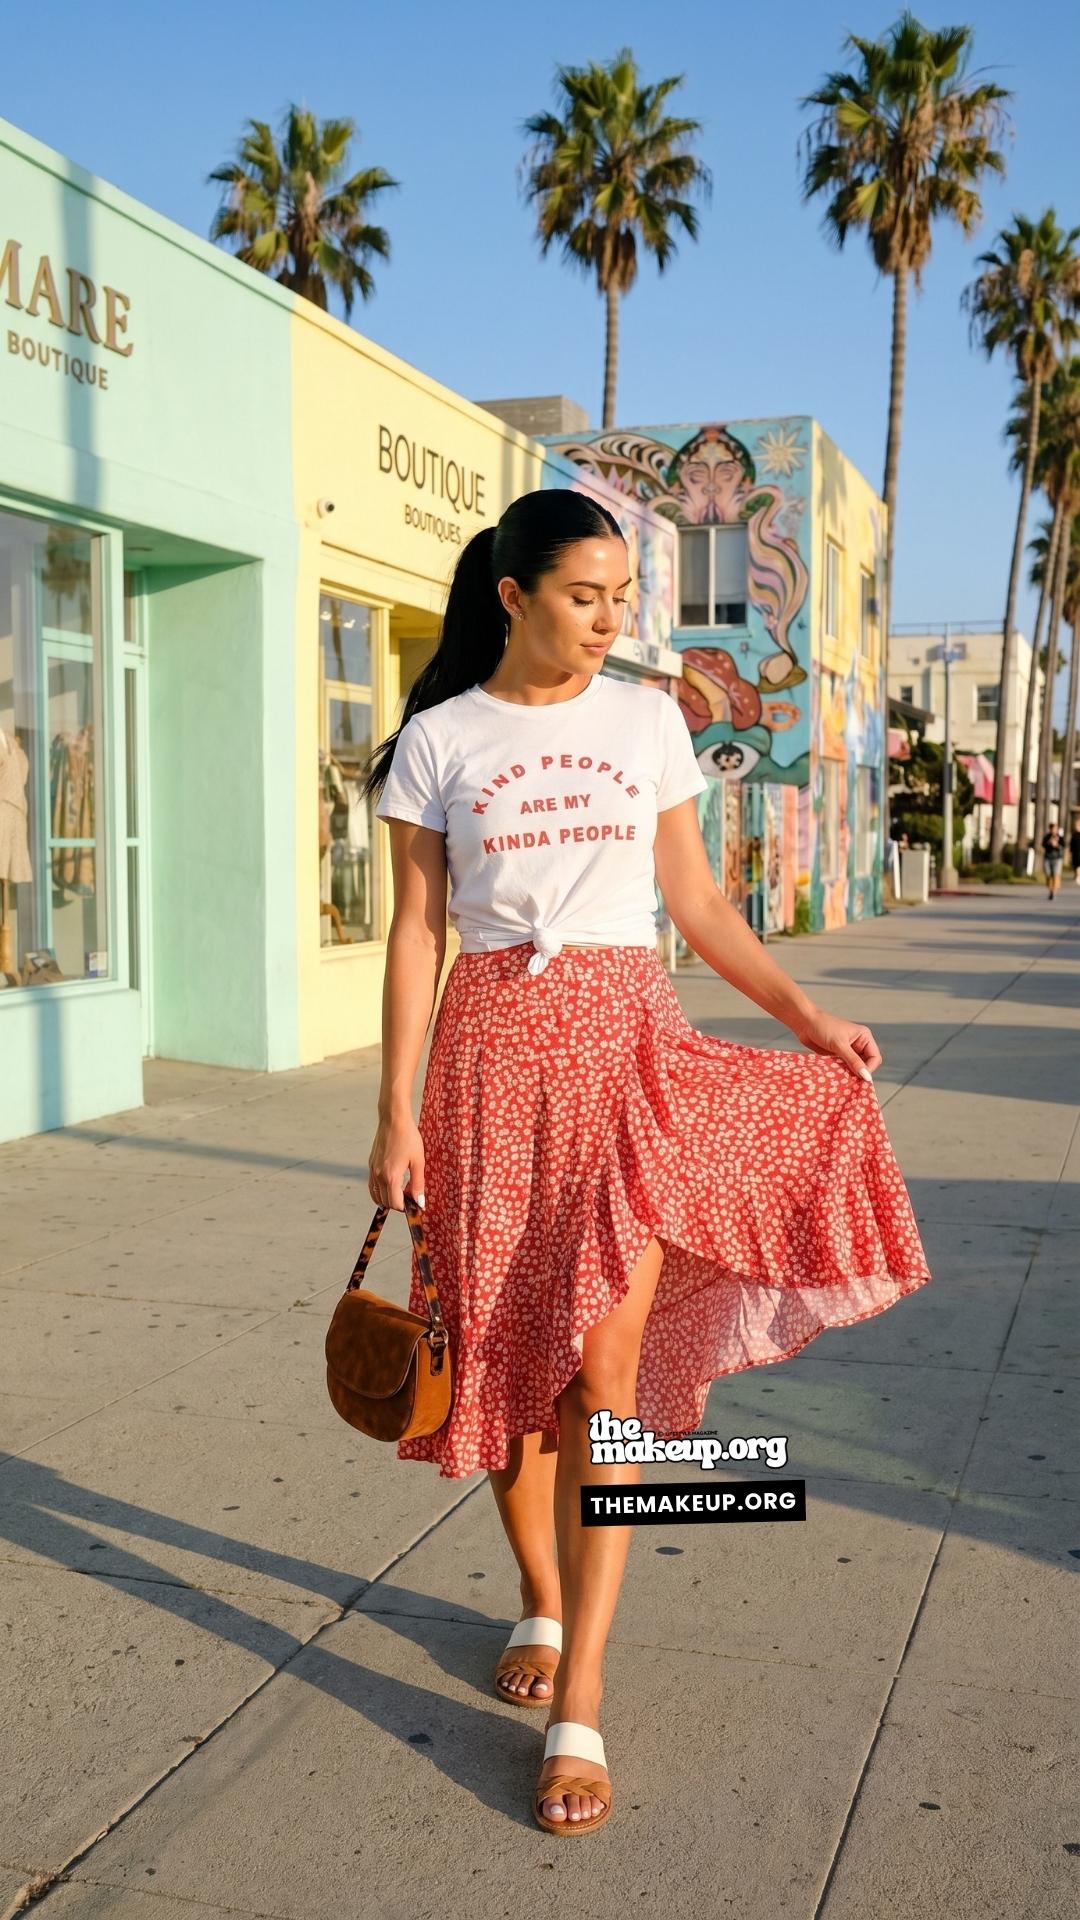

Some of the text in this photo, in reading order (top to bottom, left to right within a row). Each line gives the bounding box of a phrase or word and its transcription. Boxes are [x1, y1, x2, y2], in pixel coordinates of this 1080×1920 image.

[7, 329, 109, 390] BOUTIQUE
[379, 424, 486, 517] BOUTIQUE
[405, 503, 461, 545] BOUTIQUES
[472, 754, 640, 815] KIND PEOPLE
[520, 794, 591, 814] ARE MY
[483, 825, 636, 854] KINDA PEOPLE
